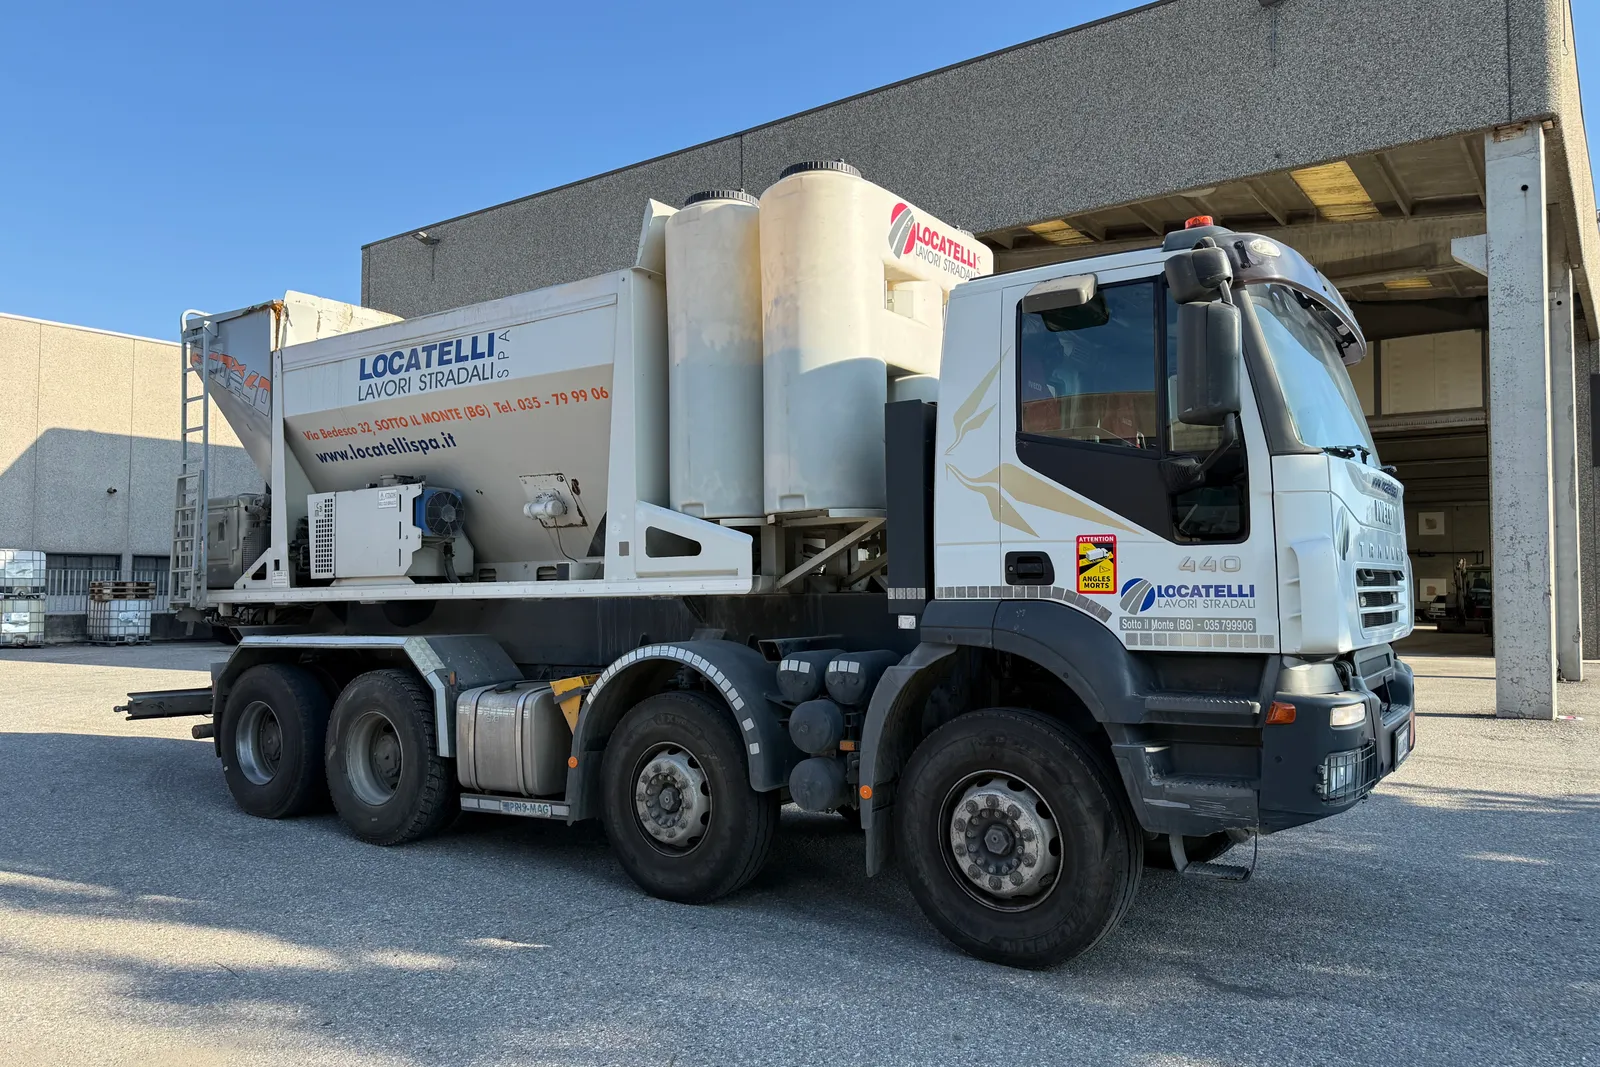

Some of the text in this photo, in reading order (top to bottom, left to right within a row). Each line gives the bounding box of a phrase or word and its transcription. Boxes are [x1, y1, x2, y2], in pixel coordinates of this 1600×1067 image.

[915, 243, 941, 268] LAVORI
[917, 222, 976, 269] LOCATELLI
[359, 332, 495, 381] LOCATELLI
[358, 361, 494, 402] LAVORI STRADALI
[303, 430, 319, 441] Via
[320, 426, 358, 440] Bedesco
[358, 421, 376, 436] 32,
[375, 416, 409, 431] SOTTO
[409, 415, 422, 427] IL
[421, 408, 463, 425] MONTE
[464, 403, 490, 421] (BG)
[493, 400, 516, 414] Tel.
[517, 396, 541, 411] 035
[551, 393, 568, 406] 79
[571, 390, 588, 404] 99
[591, 386, 609, 400] 06
[316, 432, 457, 463] www.locatellispa.it
[1178, 555, 1242, 573] 440
[1157, 584, 1255, 598] LOCATELLI
[1157, 599, 1256, 609] LAVORI STRADALI
[1122, 619, 1142, 630] Sotto
[1144, 619, 1149, 630] il
[1151, 620, 1175, 631] Monte
[1177, 619, 1194, 631] (BG)
